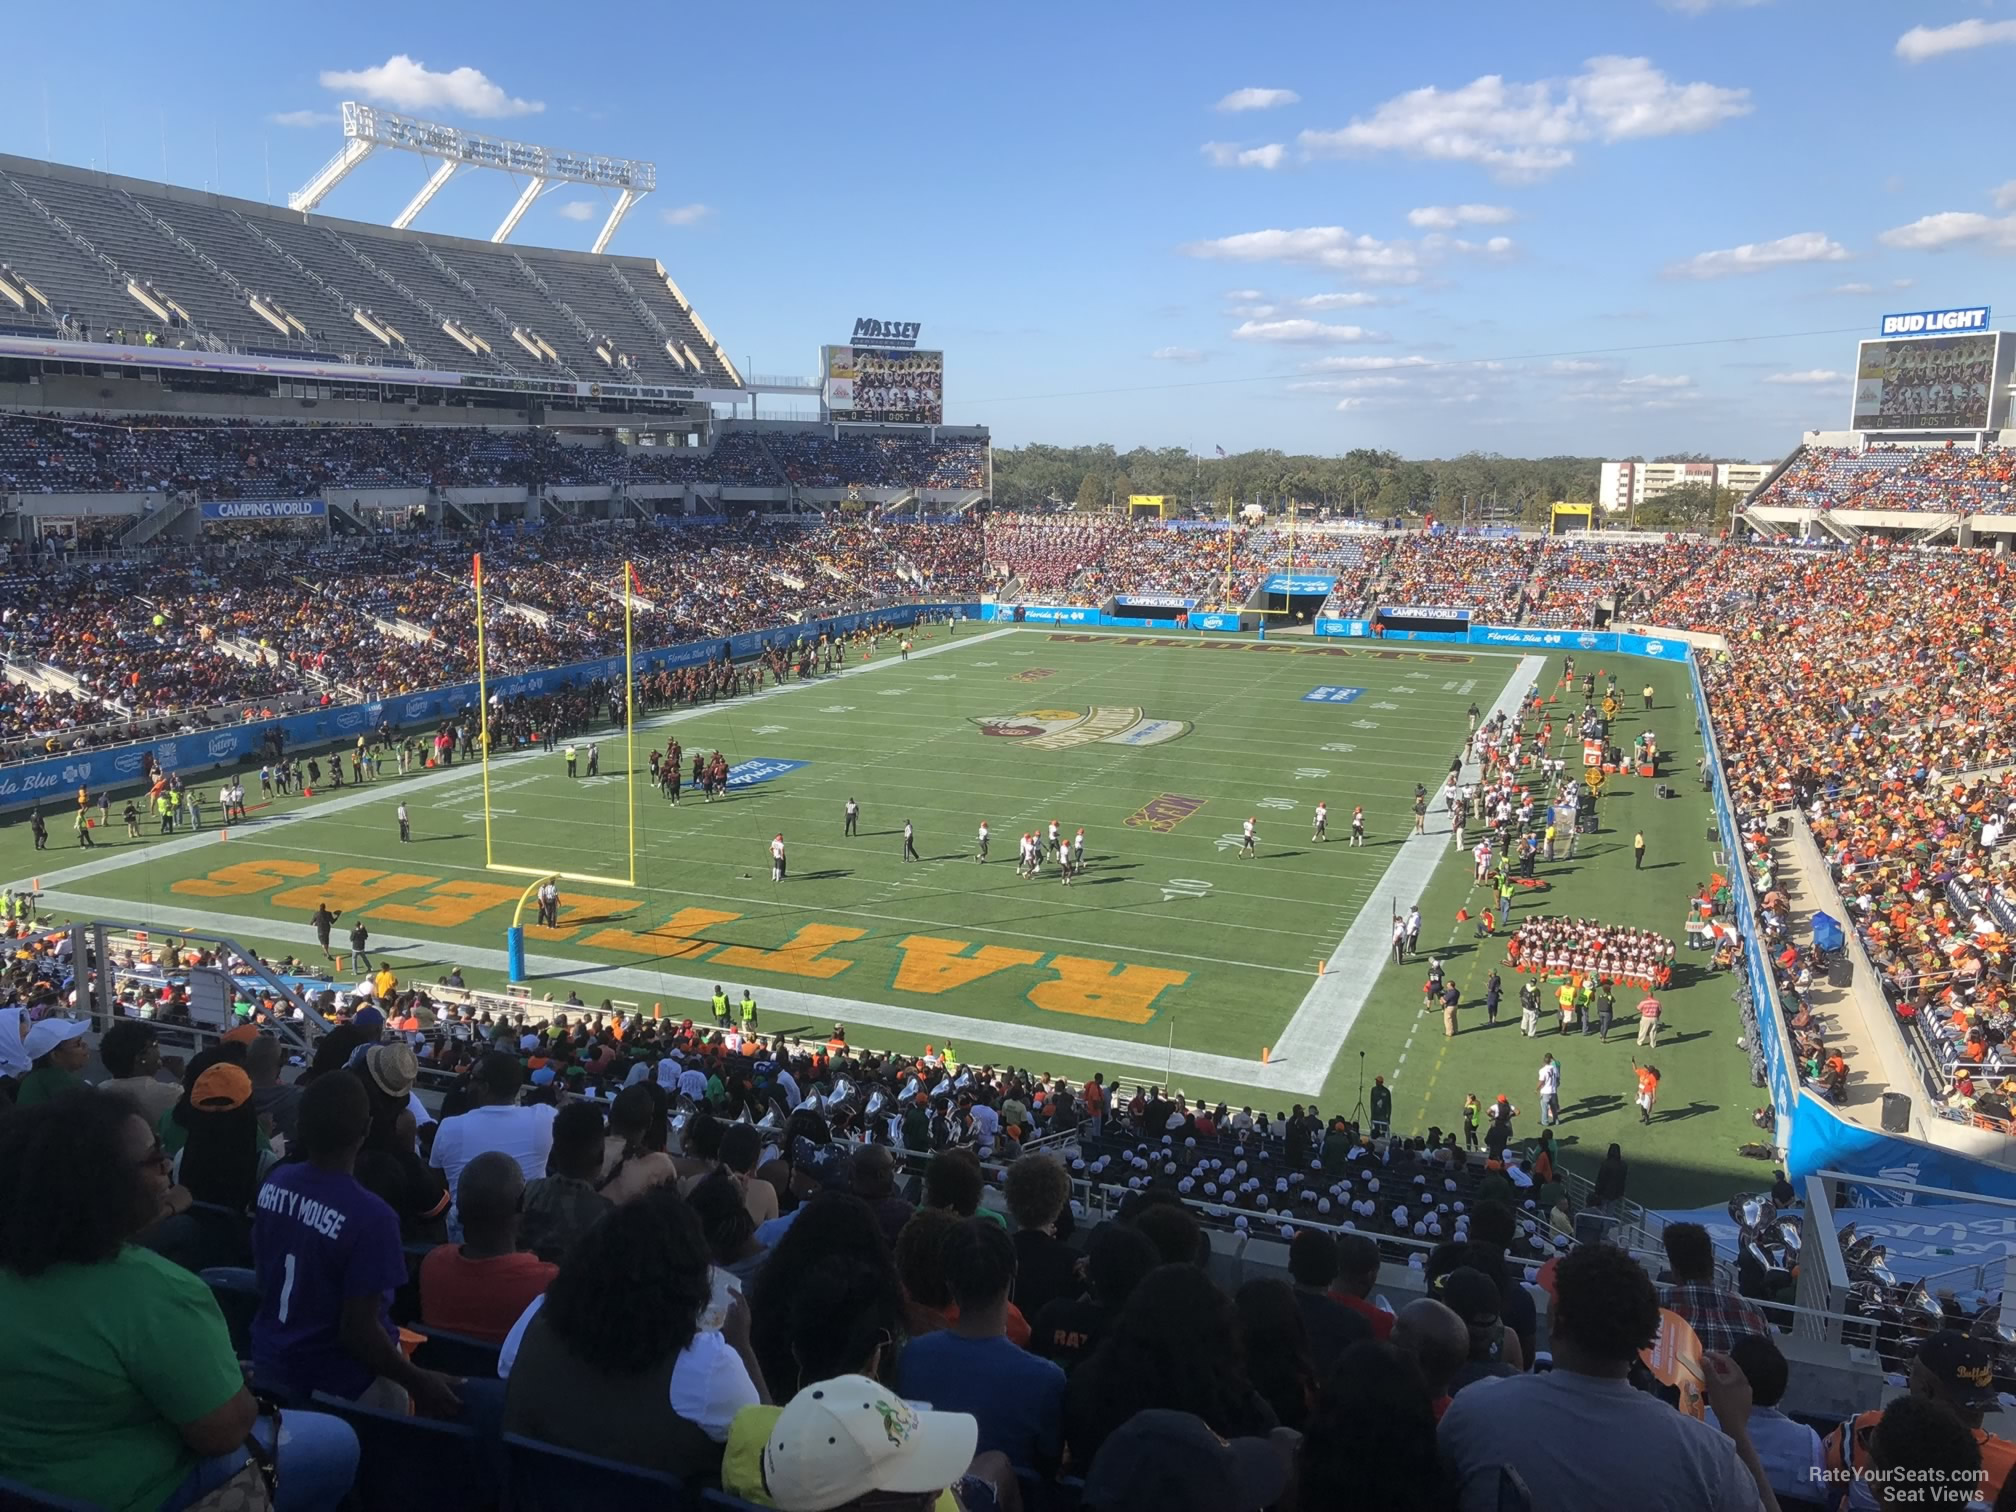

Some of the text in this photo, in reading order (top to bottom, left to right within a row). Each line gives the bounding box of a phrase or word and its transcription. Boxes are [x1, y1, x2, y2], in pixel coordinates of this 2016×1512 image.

[852, 317, 921, 339] MASSEY
[1884, 317, 1925, 333] BUD
[218, 502, 312, 516] CAMPING WORLD
[1126, 597, 1185, 607] CAMPING WORLD
[1025, 610, 1052, 619] Florida
[1392, 608, 1458, 618] CAMPING WORLD
[1487, 632, 1542, 643] Florida Blue
[668, 652, 692, 663] Florida
[405, 701, 428, 718] Lottery
[207, 736, 239, 757] Lottery
[21, 772, 58, 792] Blue
[1256, 797, 1299, 811] 30
[1160, 878, 1214, 899] 10
[169, 858, 1190, 1025] RATTLERS
[297, 1196, 347, 1240] MOUSE
[278, 1253, 296, 1324] 1
